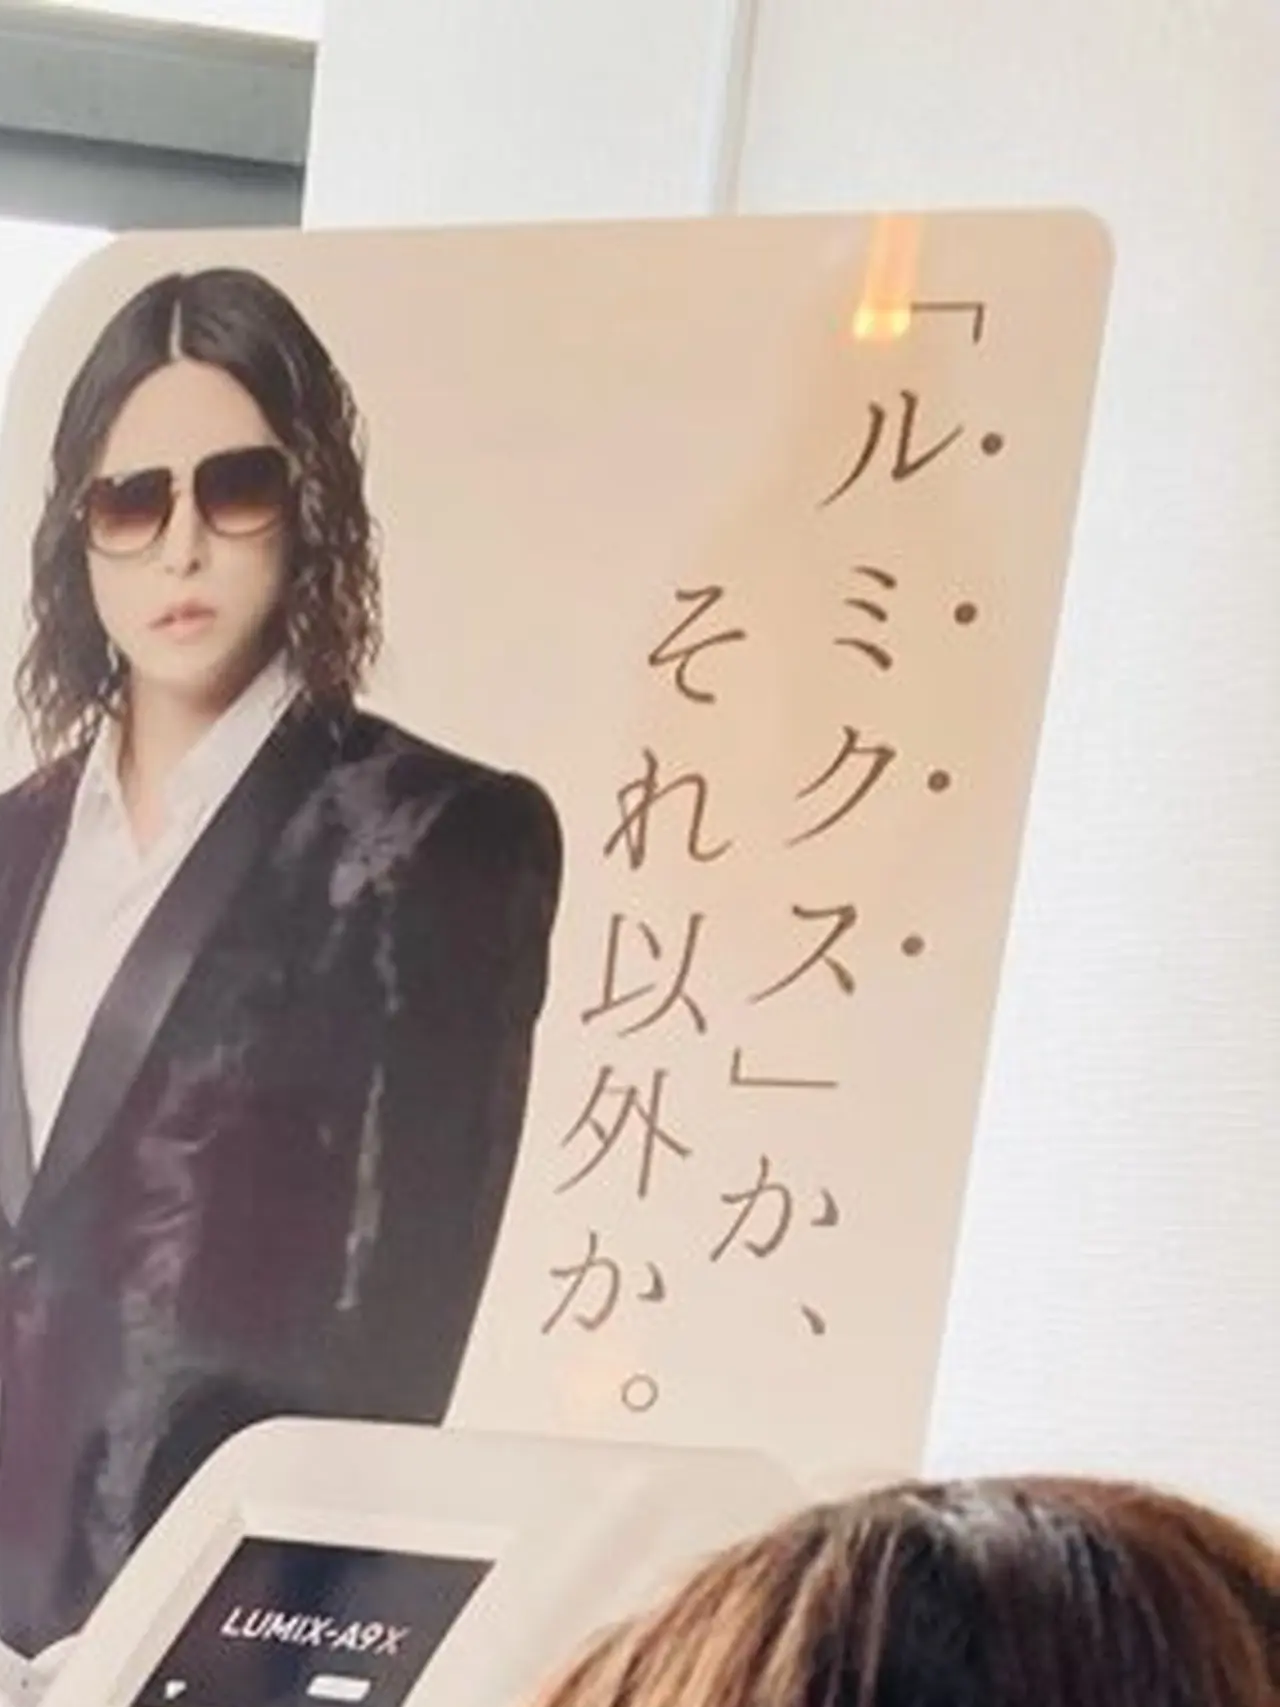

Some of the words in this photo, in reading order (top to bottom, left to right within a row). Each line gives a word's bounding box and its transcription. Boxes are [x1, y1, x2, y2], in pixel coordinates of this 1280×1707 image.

[539, 583, 750, 1414] それ以外か。
[220, 1606, 410, 1656] LUMIX-A9X
